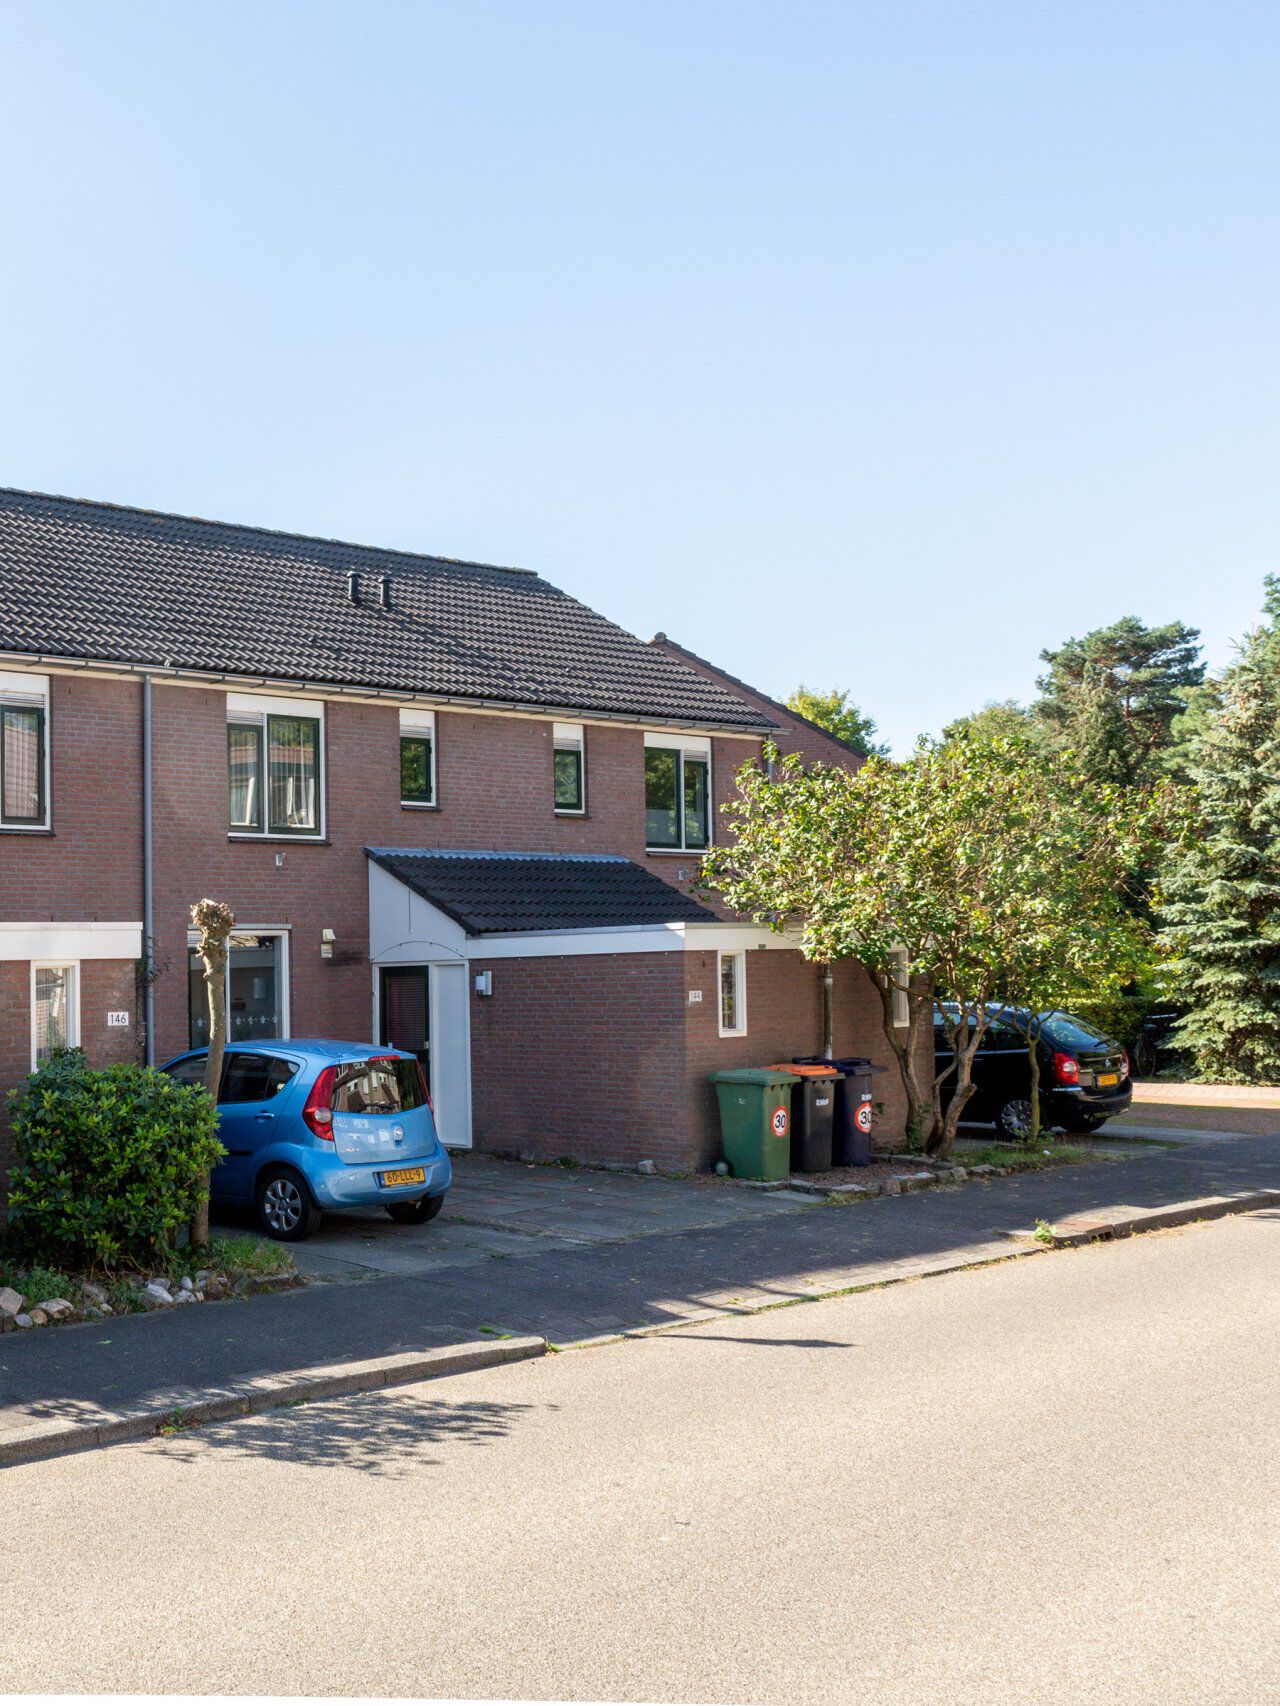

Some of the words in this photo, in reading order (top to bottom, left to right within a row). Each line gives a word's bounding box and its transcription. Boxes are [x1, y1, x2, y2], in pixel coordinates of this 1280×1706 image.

[110, 1013, 127, 1025] 146
[774, 1114, 786, 1129] 30
[387, 1169, 421, 1183] 60-LLL-9
